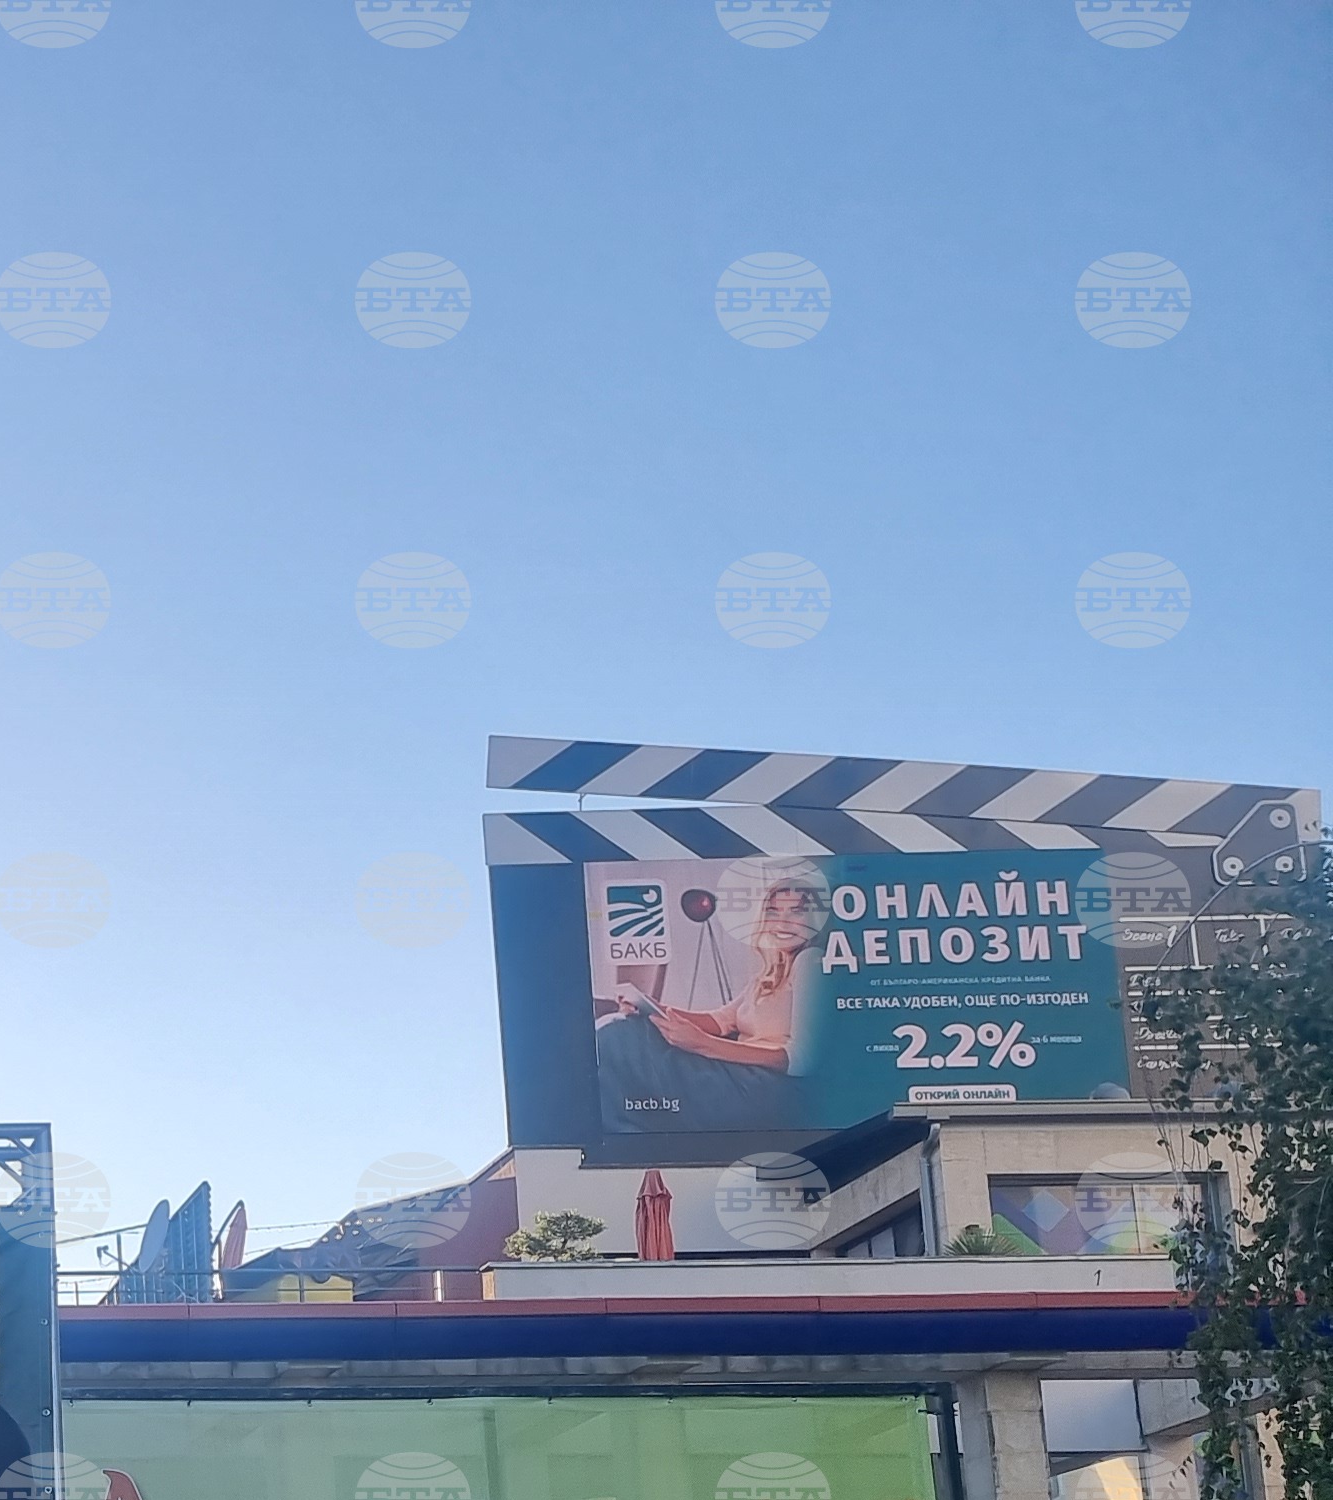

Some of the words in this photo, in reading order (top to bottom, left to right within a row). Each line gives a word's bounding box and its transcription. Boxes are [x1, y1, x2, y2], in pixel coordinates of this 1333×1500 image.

[832, 870, 1070, 921] ОНЛАЙН
[610, 942, 667, 960] БАКБ
[822, 924, 1087, 974] ДЕПОЗИТ
[836, 998, 862, 1009] ВСЕ
[865, 997, 901, 1009] ТАКА
[903, 996, 962, 1010] УДОБЕН,
[964, 995, 997, 1009] ОЩЕ
[999, 992, 1089, 1007] ПО-ИЗГОДЕН
[892, 1020, 1036, 1069] 2.2%
[915, 1089, 961, 1101] ОТКРИЙ
[962, 1088, 1011, 1100] ОНЛАЙН
[624, 1097, 680, 1112] bacb.bg
